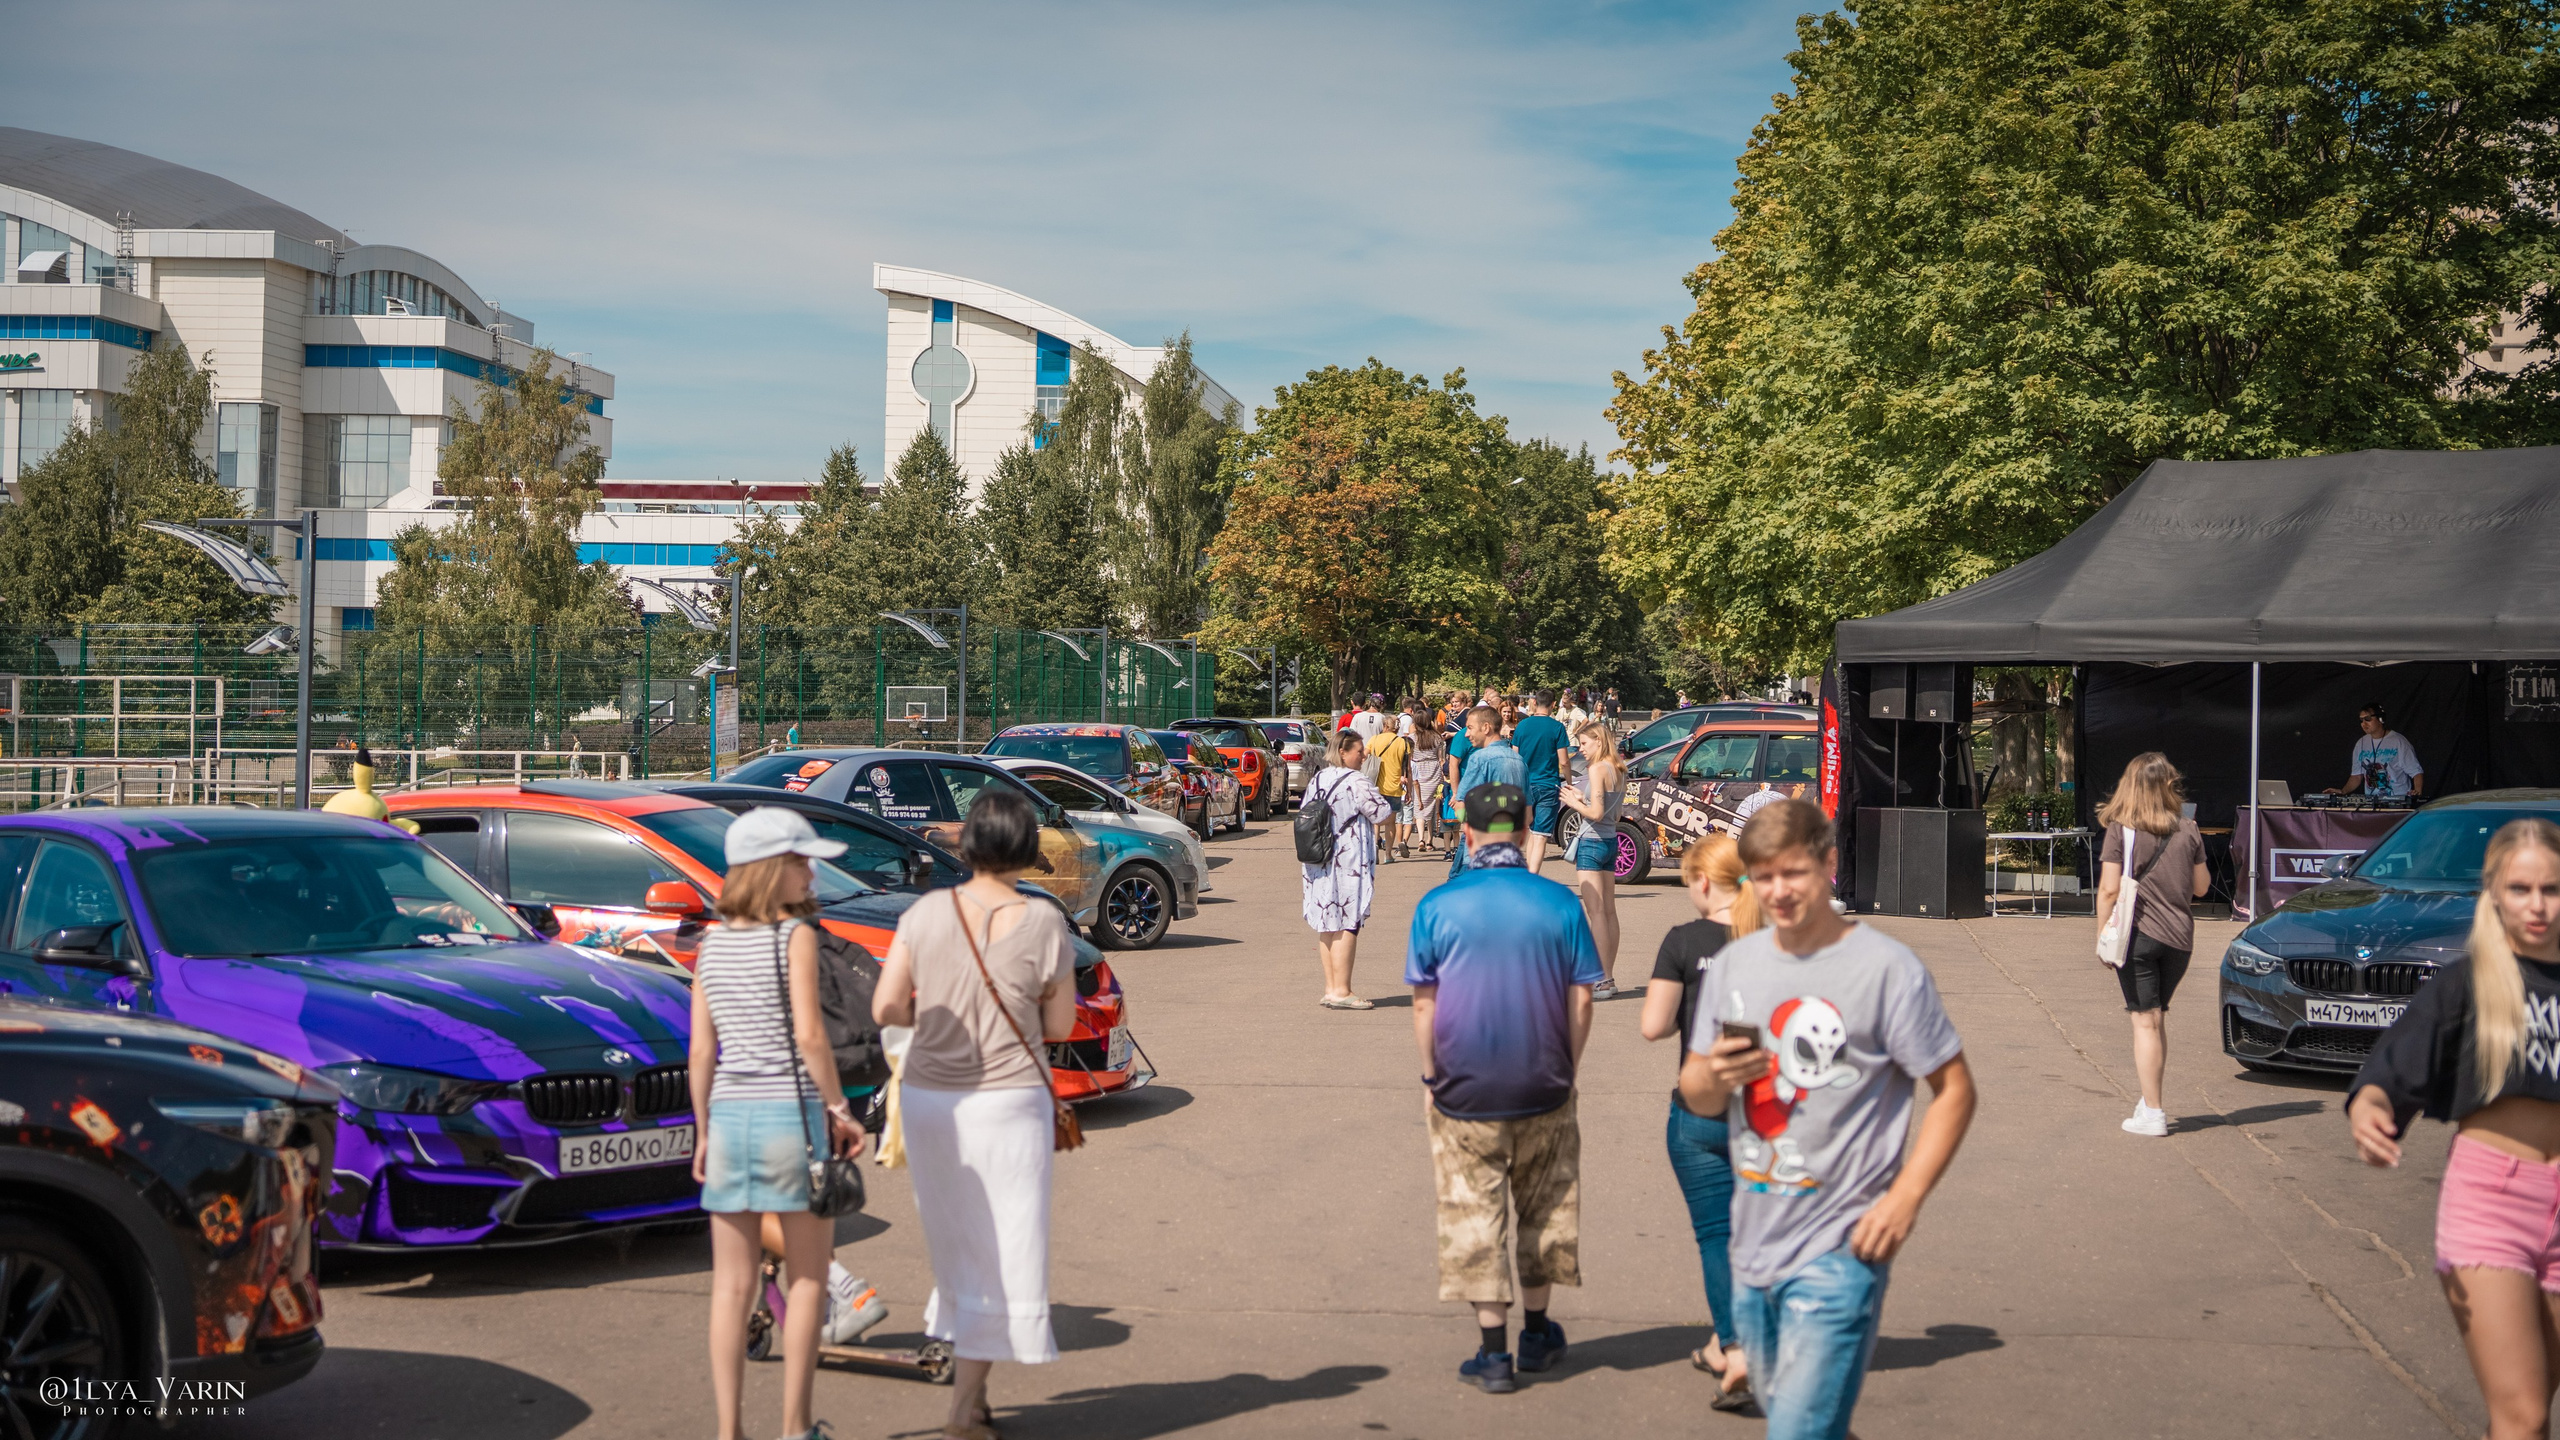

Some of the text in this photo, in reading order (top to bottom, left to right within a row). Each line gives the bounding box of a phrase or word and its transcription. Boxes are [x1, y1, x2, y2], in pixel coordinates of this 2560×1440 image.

[2515, 677, 2556, 698] TIM
[1656, 781, 1694, 803] MAY THE
[668, 1128, 686, 1149] 77
